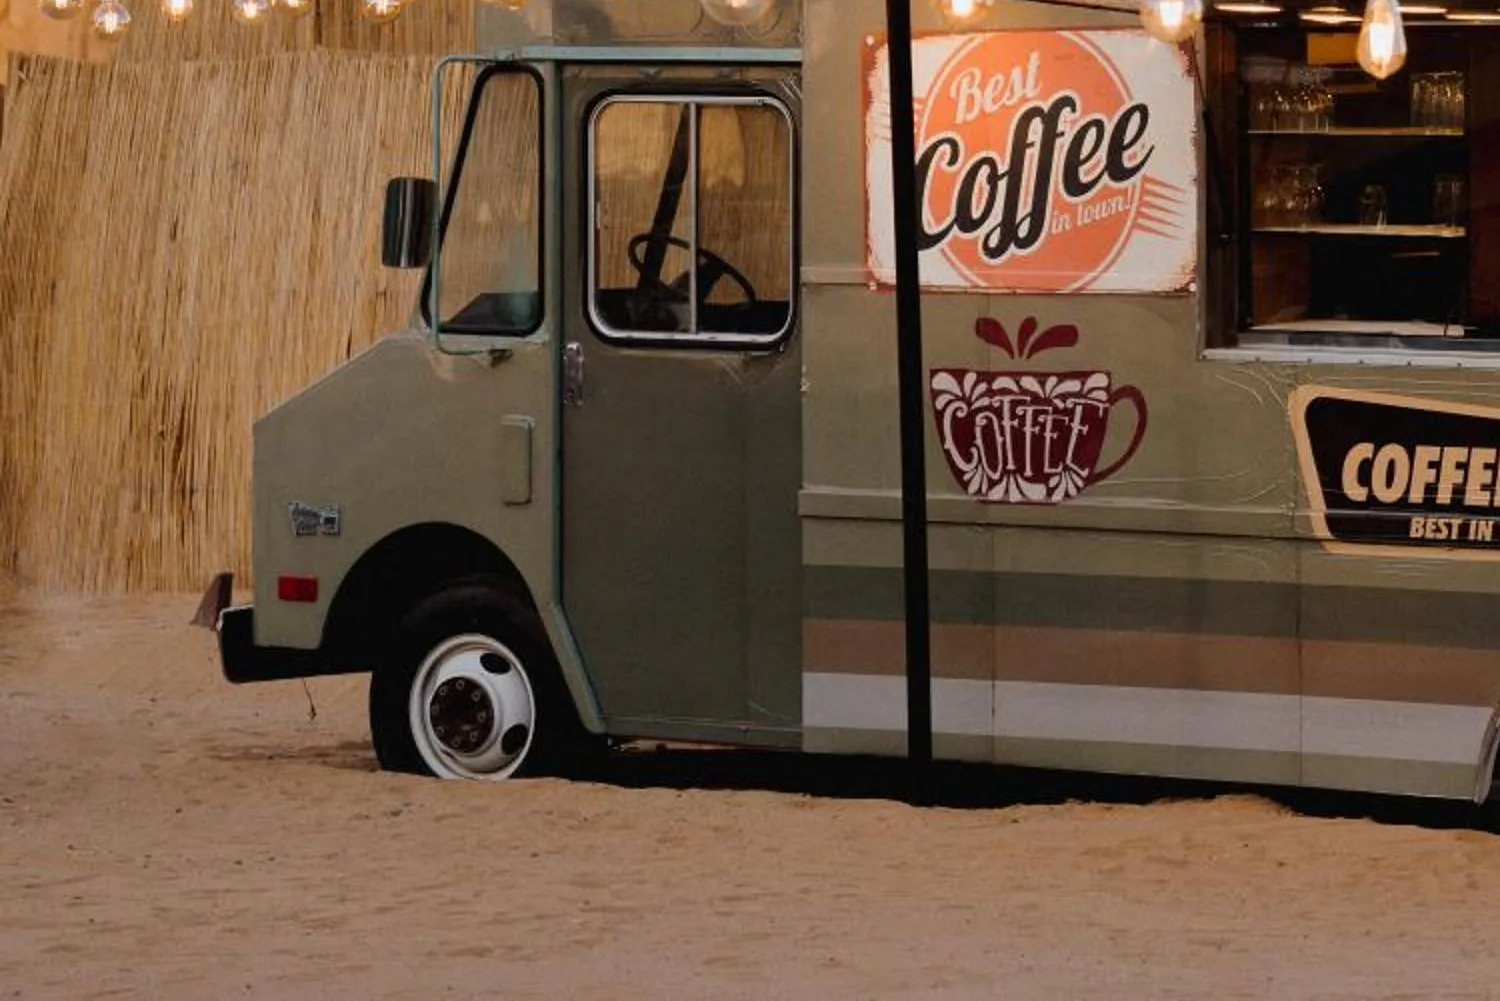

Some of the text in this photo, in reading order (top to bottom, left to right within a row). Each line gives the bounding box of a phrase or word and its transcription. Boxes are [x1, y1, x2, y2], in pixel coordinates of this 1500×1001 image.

[951, 51, 1041, 124] Best
[914, 94, 1155, 259] Coffee
[1051, 210, 1073, 235] in
[942, 395, 1110, 481] COFFEE
[1409, 515, 1463, 541] BEST
[1468, 519, 1495, 542] IN
